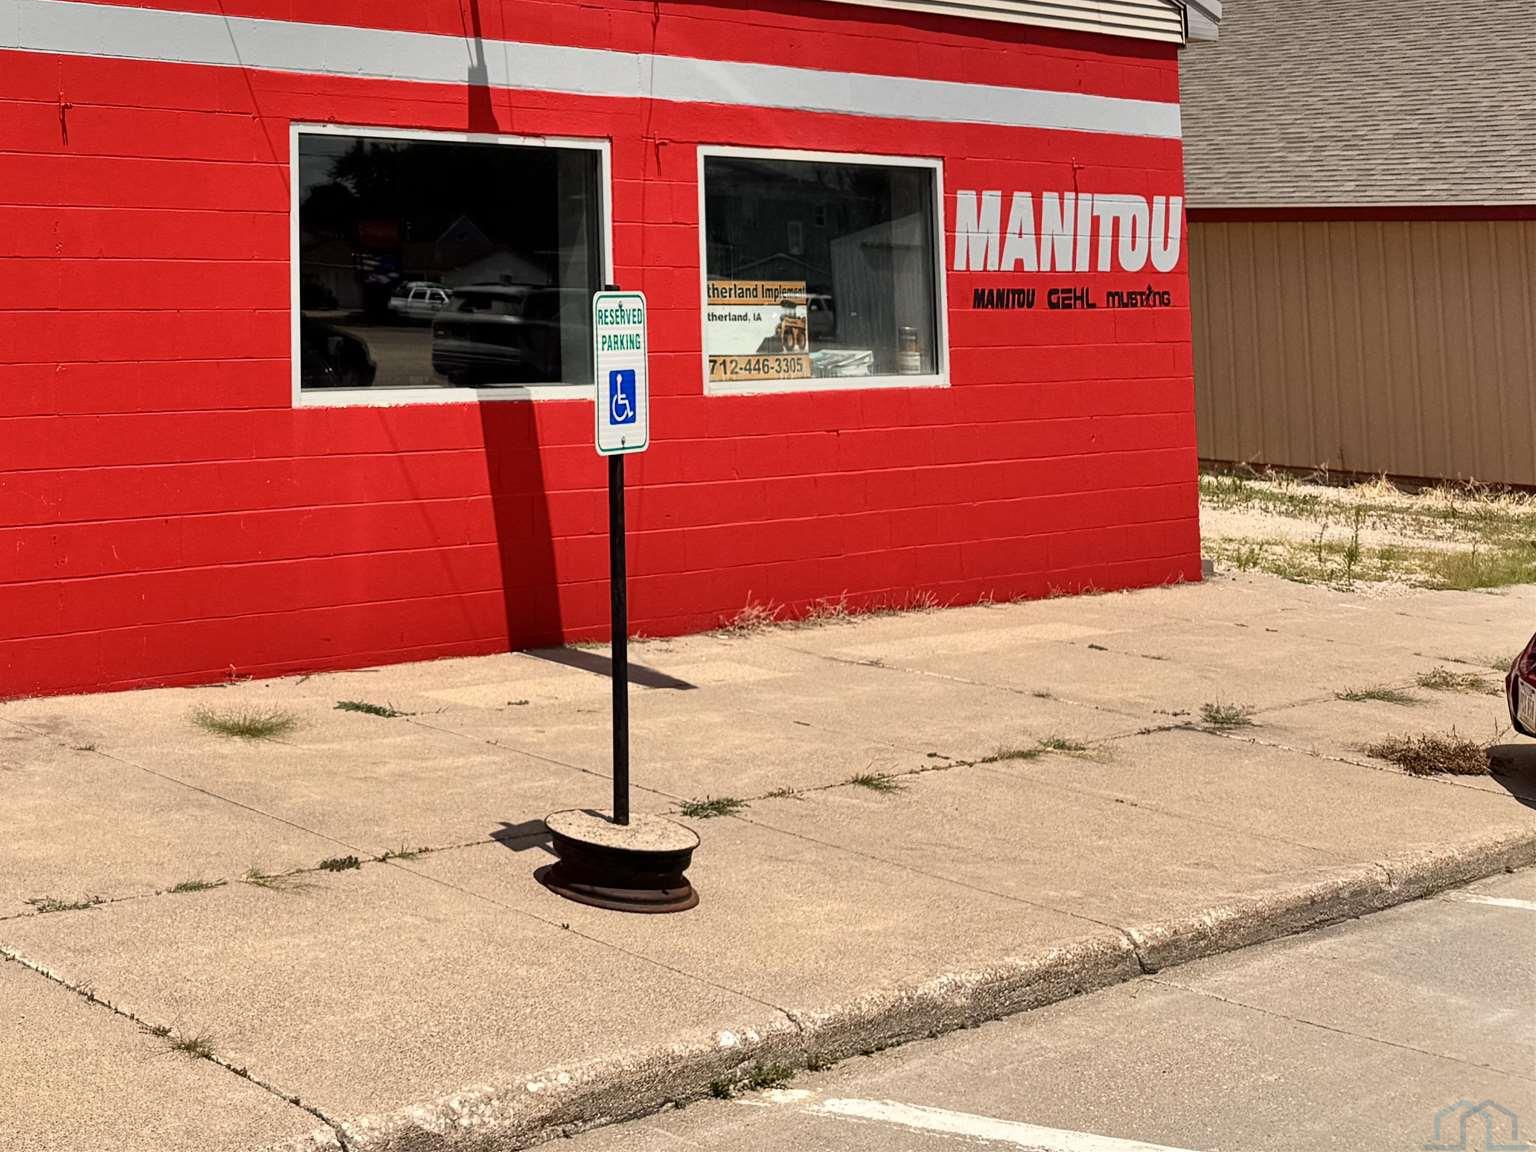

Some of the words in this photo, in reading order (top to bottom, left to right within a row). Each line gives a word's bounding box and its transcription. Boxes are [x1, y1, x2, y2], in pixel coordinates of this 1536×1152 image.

[953, 190, 1183, 273] MANITOU
[972, 288, 1036, 310] MANITOU
[1047, 287, 1097, 309] GEHL
[598, 308, 643, 326] RESERVED
[753, 313, 762, 322] IA
[601, 333, 641, 351] PARKING
[708, 357, 803, 376] 712-446-3305
